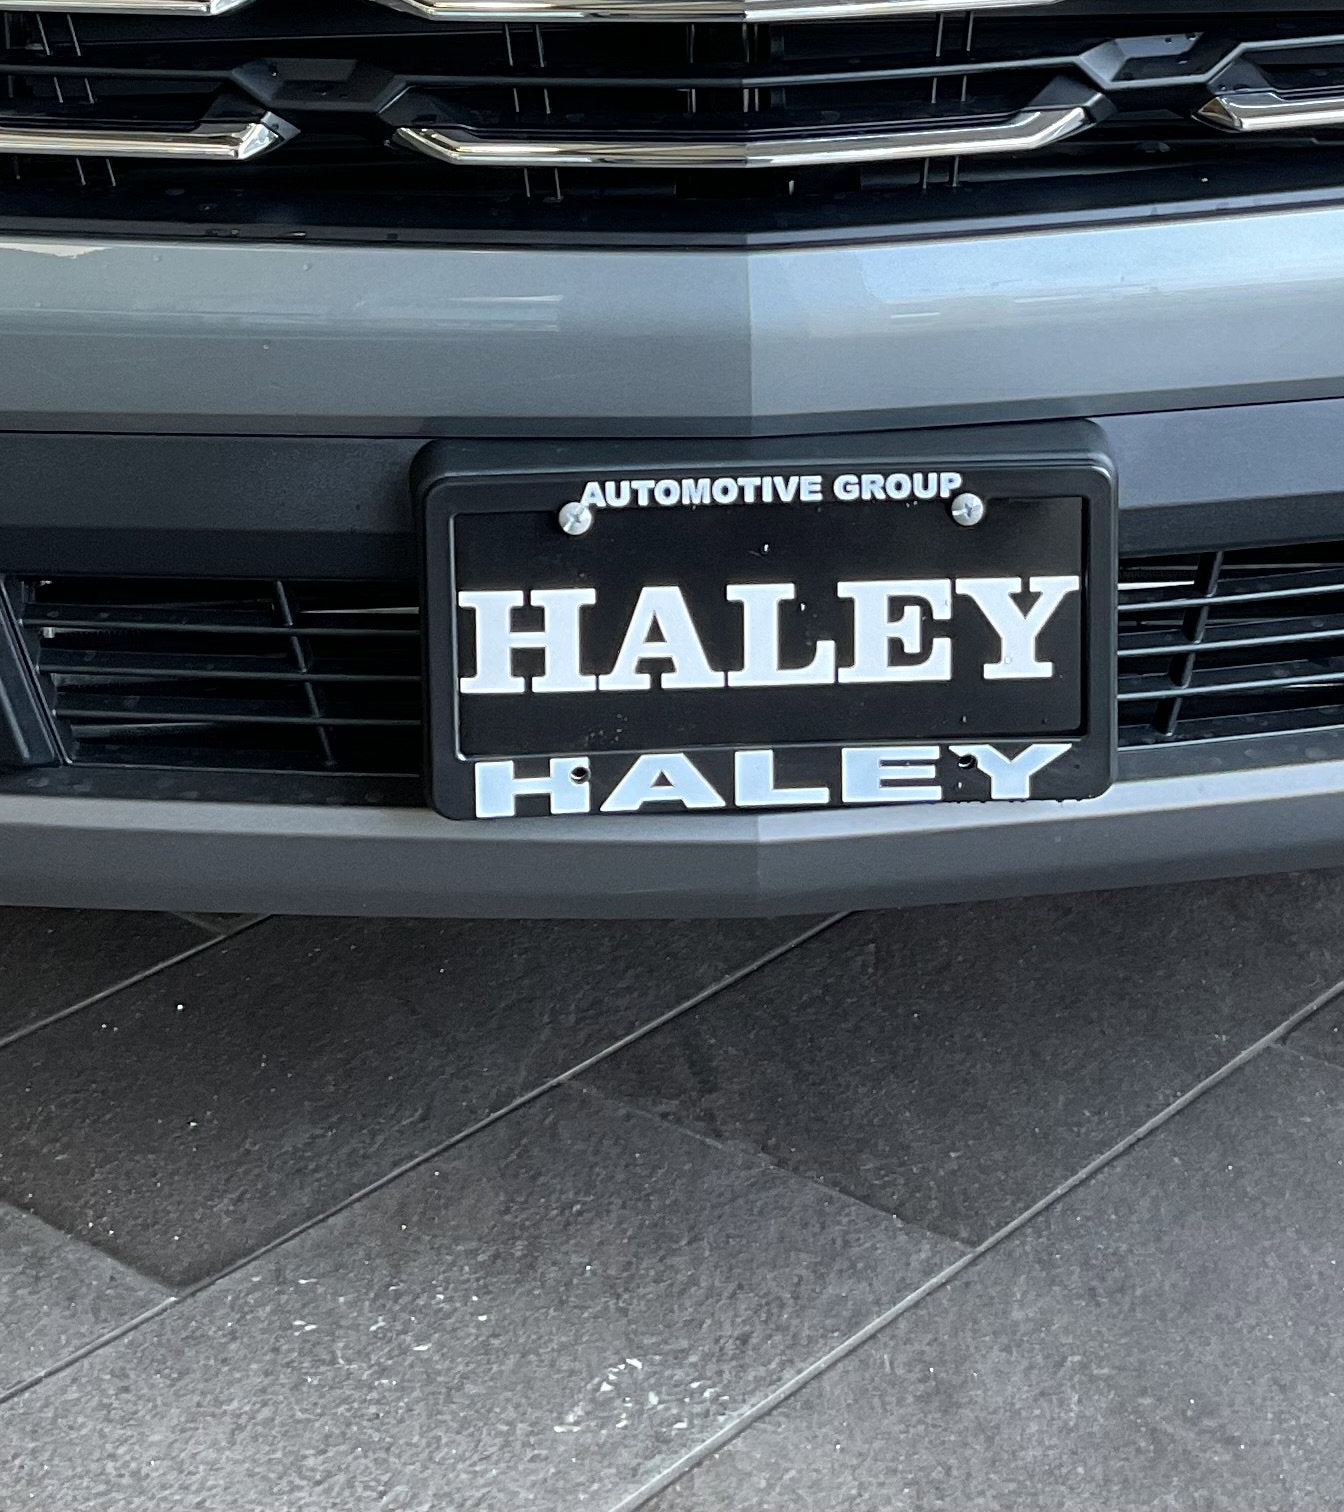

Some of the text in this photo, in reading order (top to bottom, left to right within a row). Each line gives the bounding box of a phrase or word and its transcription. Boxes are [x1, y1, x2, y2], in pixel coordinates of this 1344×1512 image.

[579, 472, 962, 509] AUTOMOTIVE GROUP
[458, 575, 1080, 694] HALEY
[474, 742, 1073, 819] HALEY
